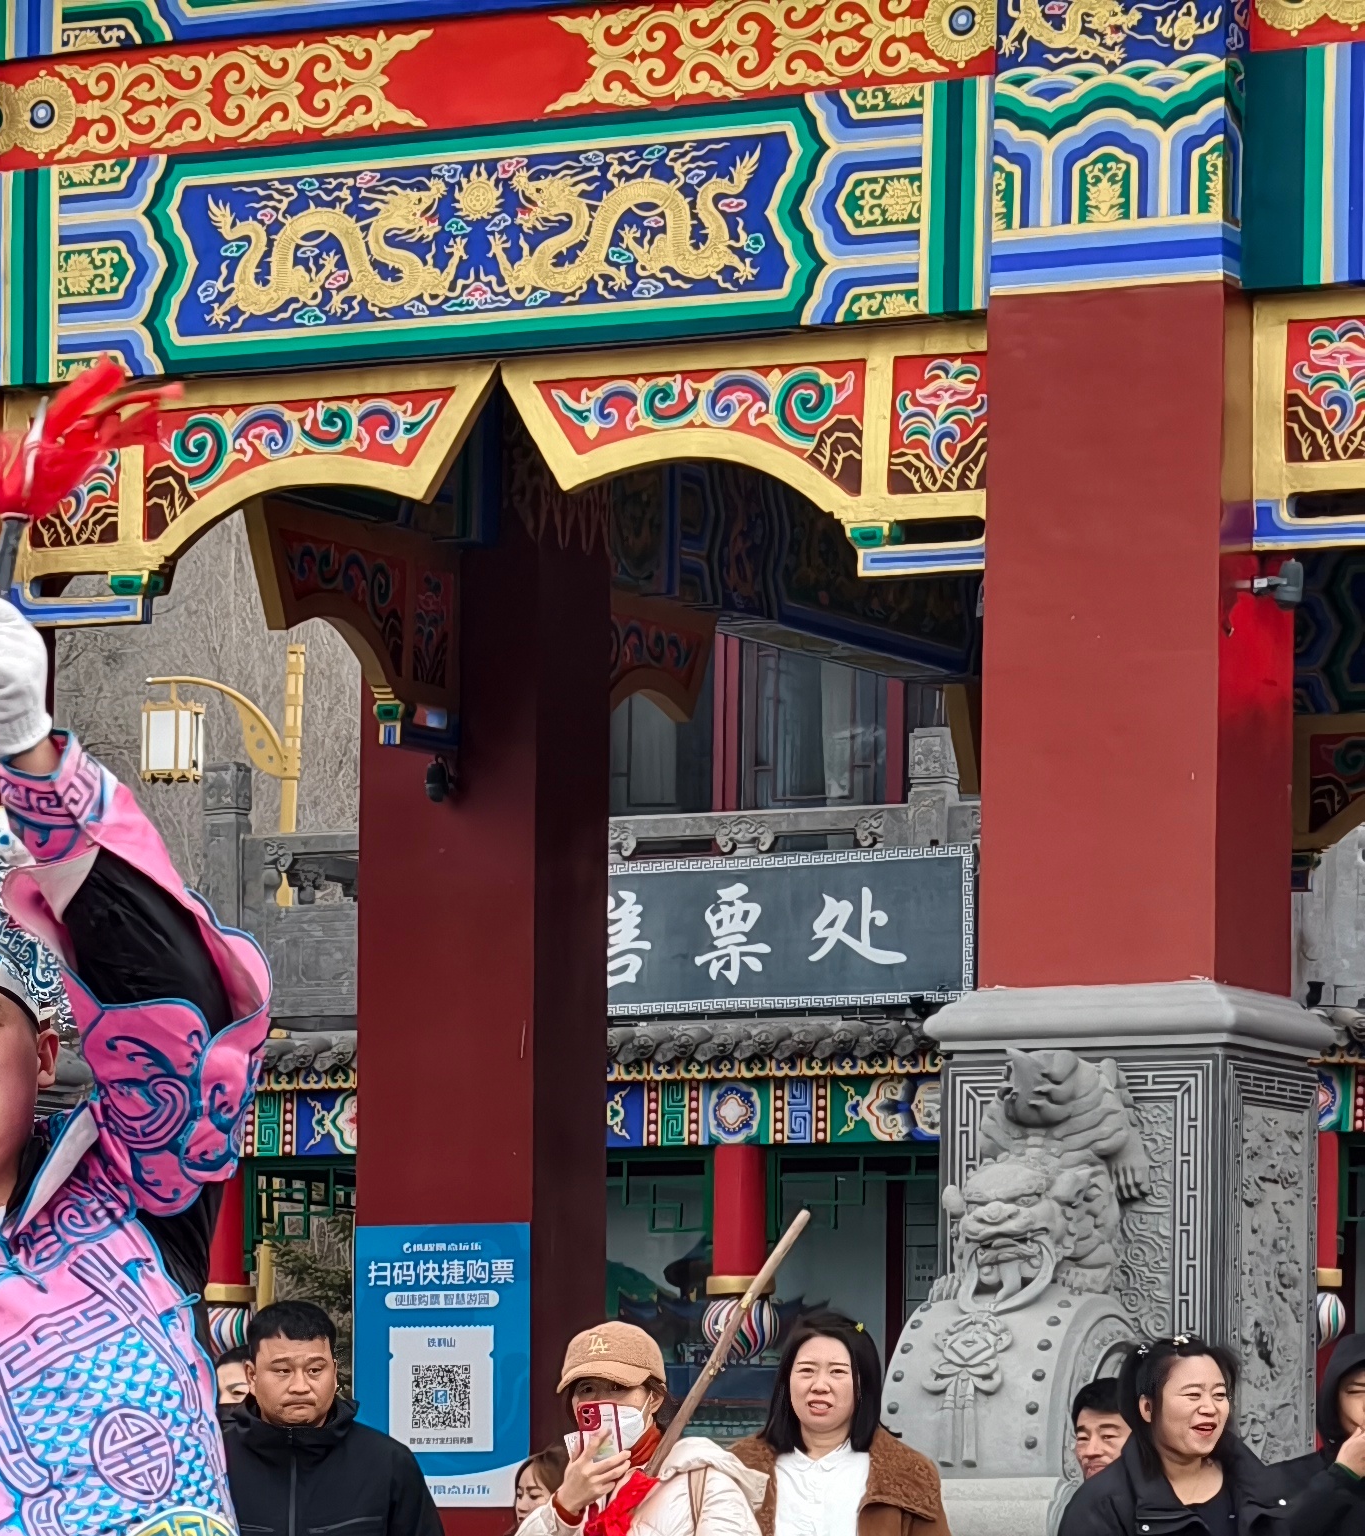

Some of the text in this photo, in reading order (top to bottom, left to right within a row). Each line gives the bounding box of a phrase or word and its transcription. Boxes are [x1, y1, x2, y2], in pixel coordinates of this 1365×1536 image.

[608, 882, 907, 988] 售票处
[367, 1258, 515, 1287] 扫码快捷购票
[588, 1334, 610, 1356] LA
